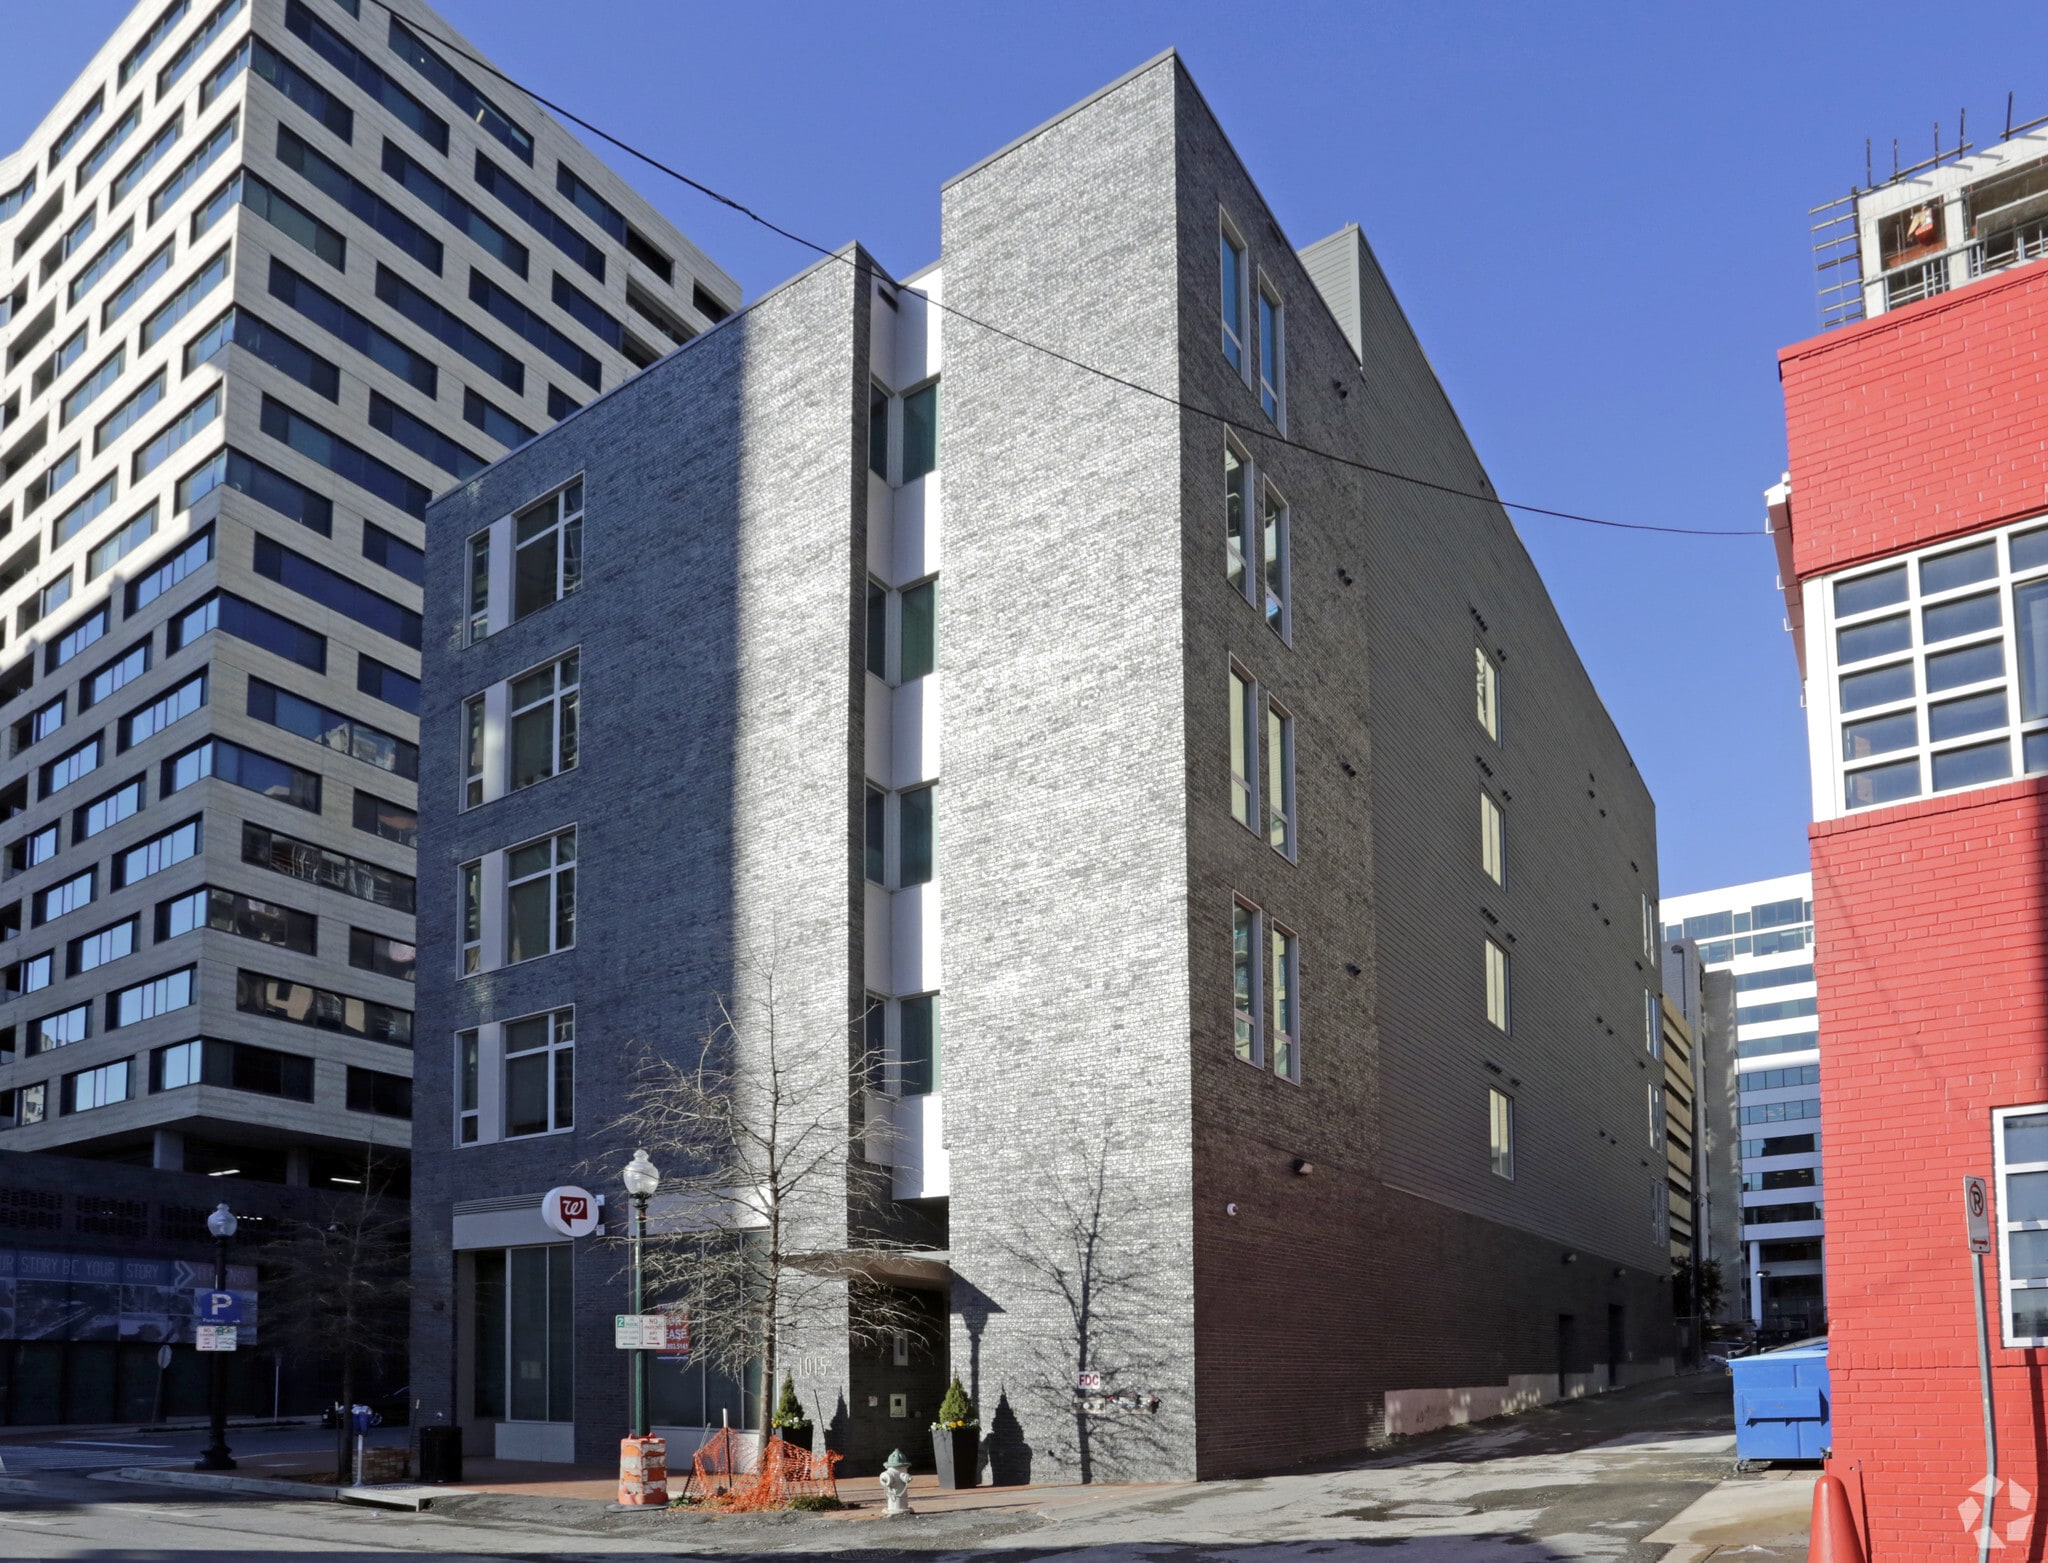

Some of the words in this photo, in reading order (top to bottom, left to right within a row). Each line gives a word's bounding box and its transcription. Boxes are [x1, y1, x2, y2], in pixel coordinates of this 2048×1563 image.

[21, 1256, 58, 1274] STORY
[86, 1260, 115, 1277] YOUR
[126, 1263, 159, 1280] STORY
[212, 1294, 232, 1315] P
[799, 1356, 827, 1377] 1015
[1079, 1374, 1099, 1386] FDC
